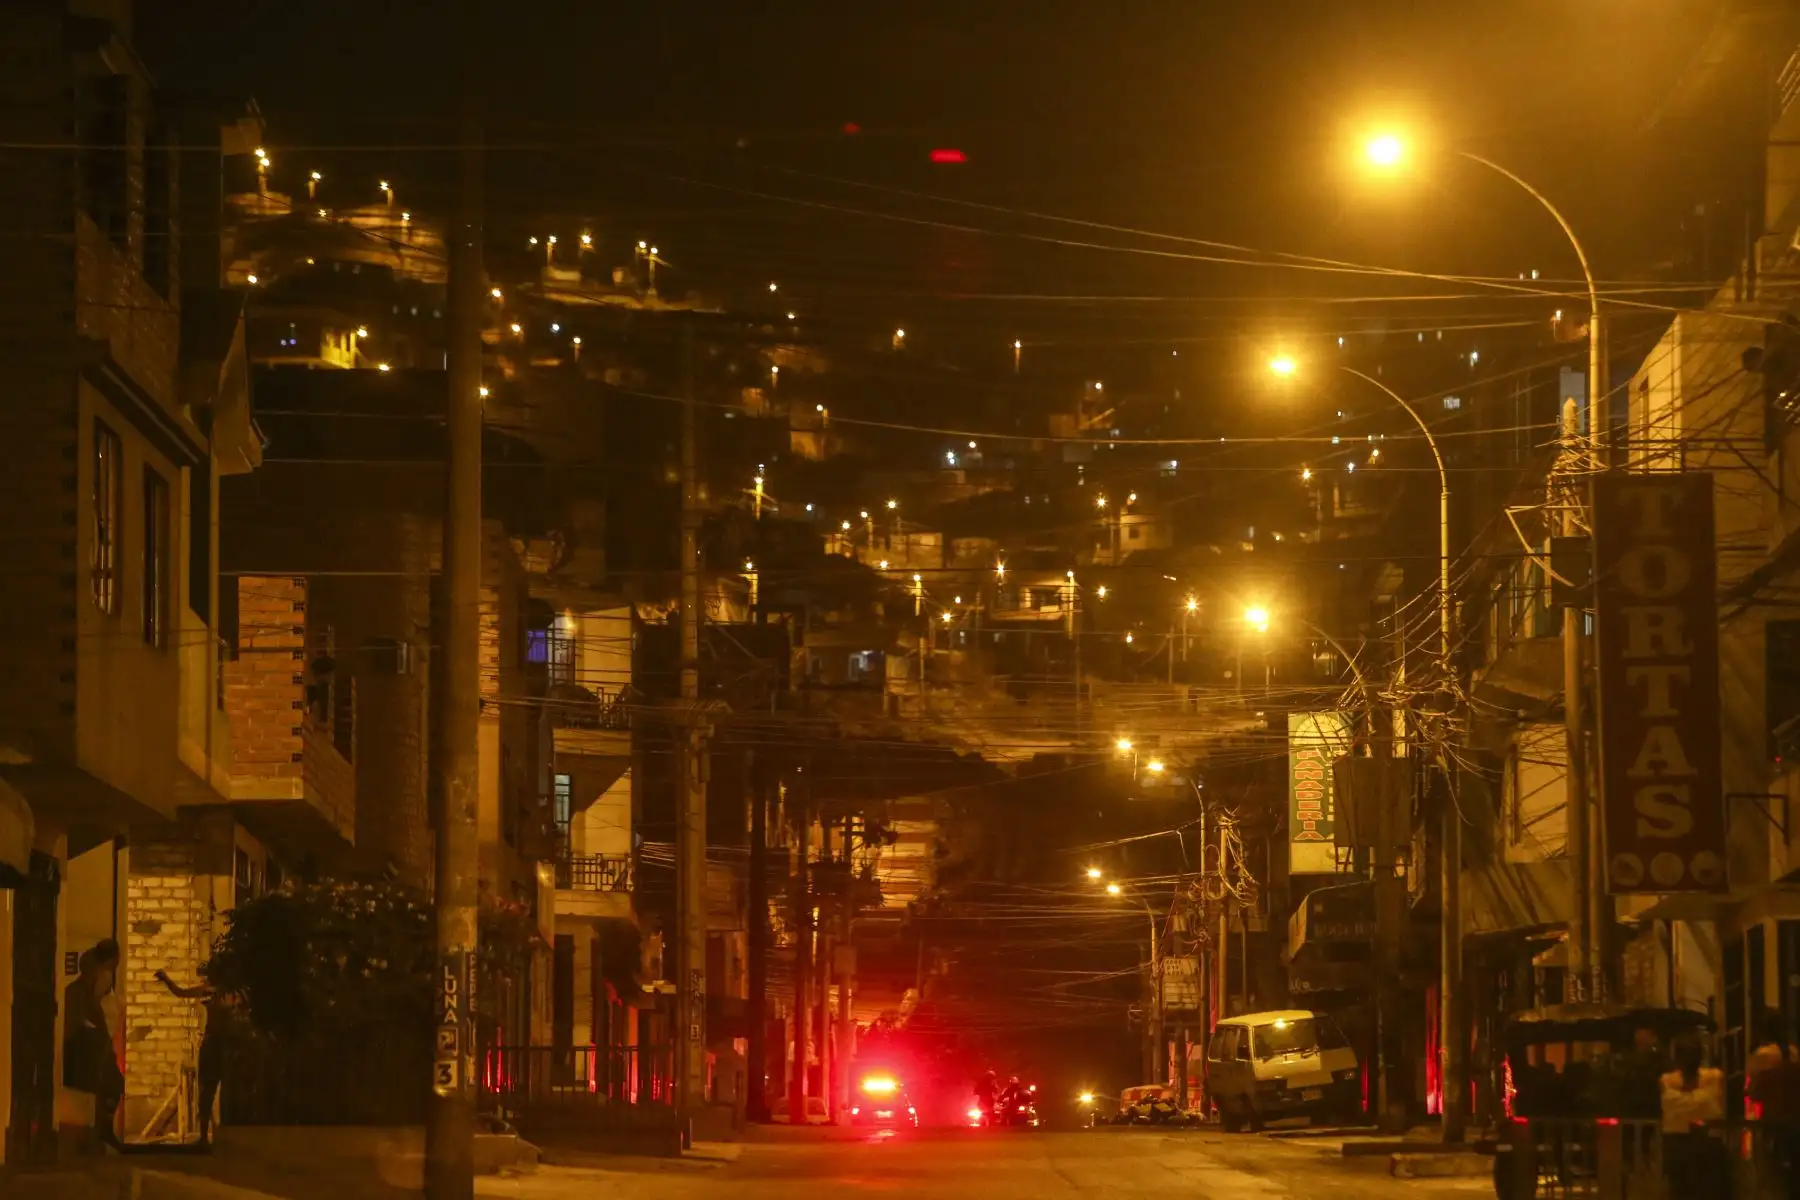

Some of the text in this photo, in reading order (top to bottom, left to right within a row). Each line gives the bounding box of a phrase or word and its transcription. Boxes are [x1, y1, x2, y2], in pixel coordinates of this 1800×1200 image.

[1617, 485, 1698, 838] TORTAS
[1294, 750, 1325, 841] PANADERIA
[443, 965, 458, 1024] LUNA
[437, 1063, 453, 1085] 3
